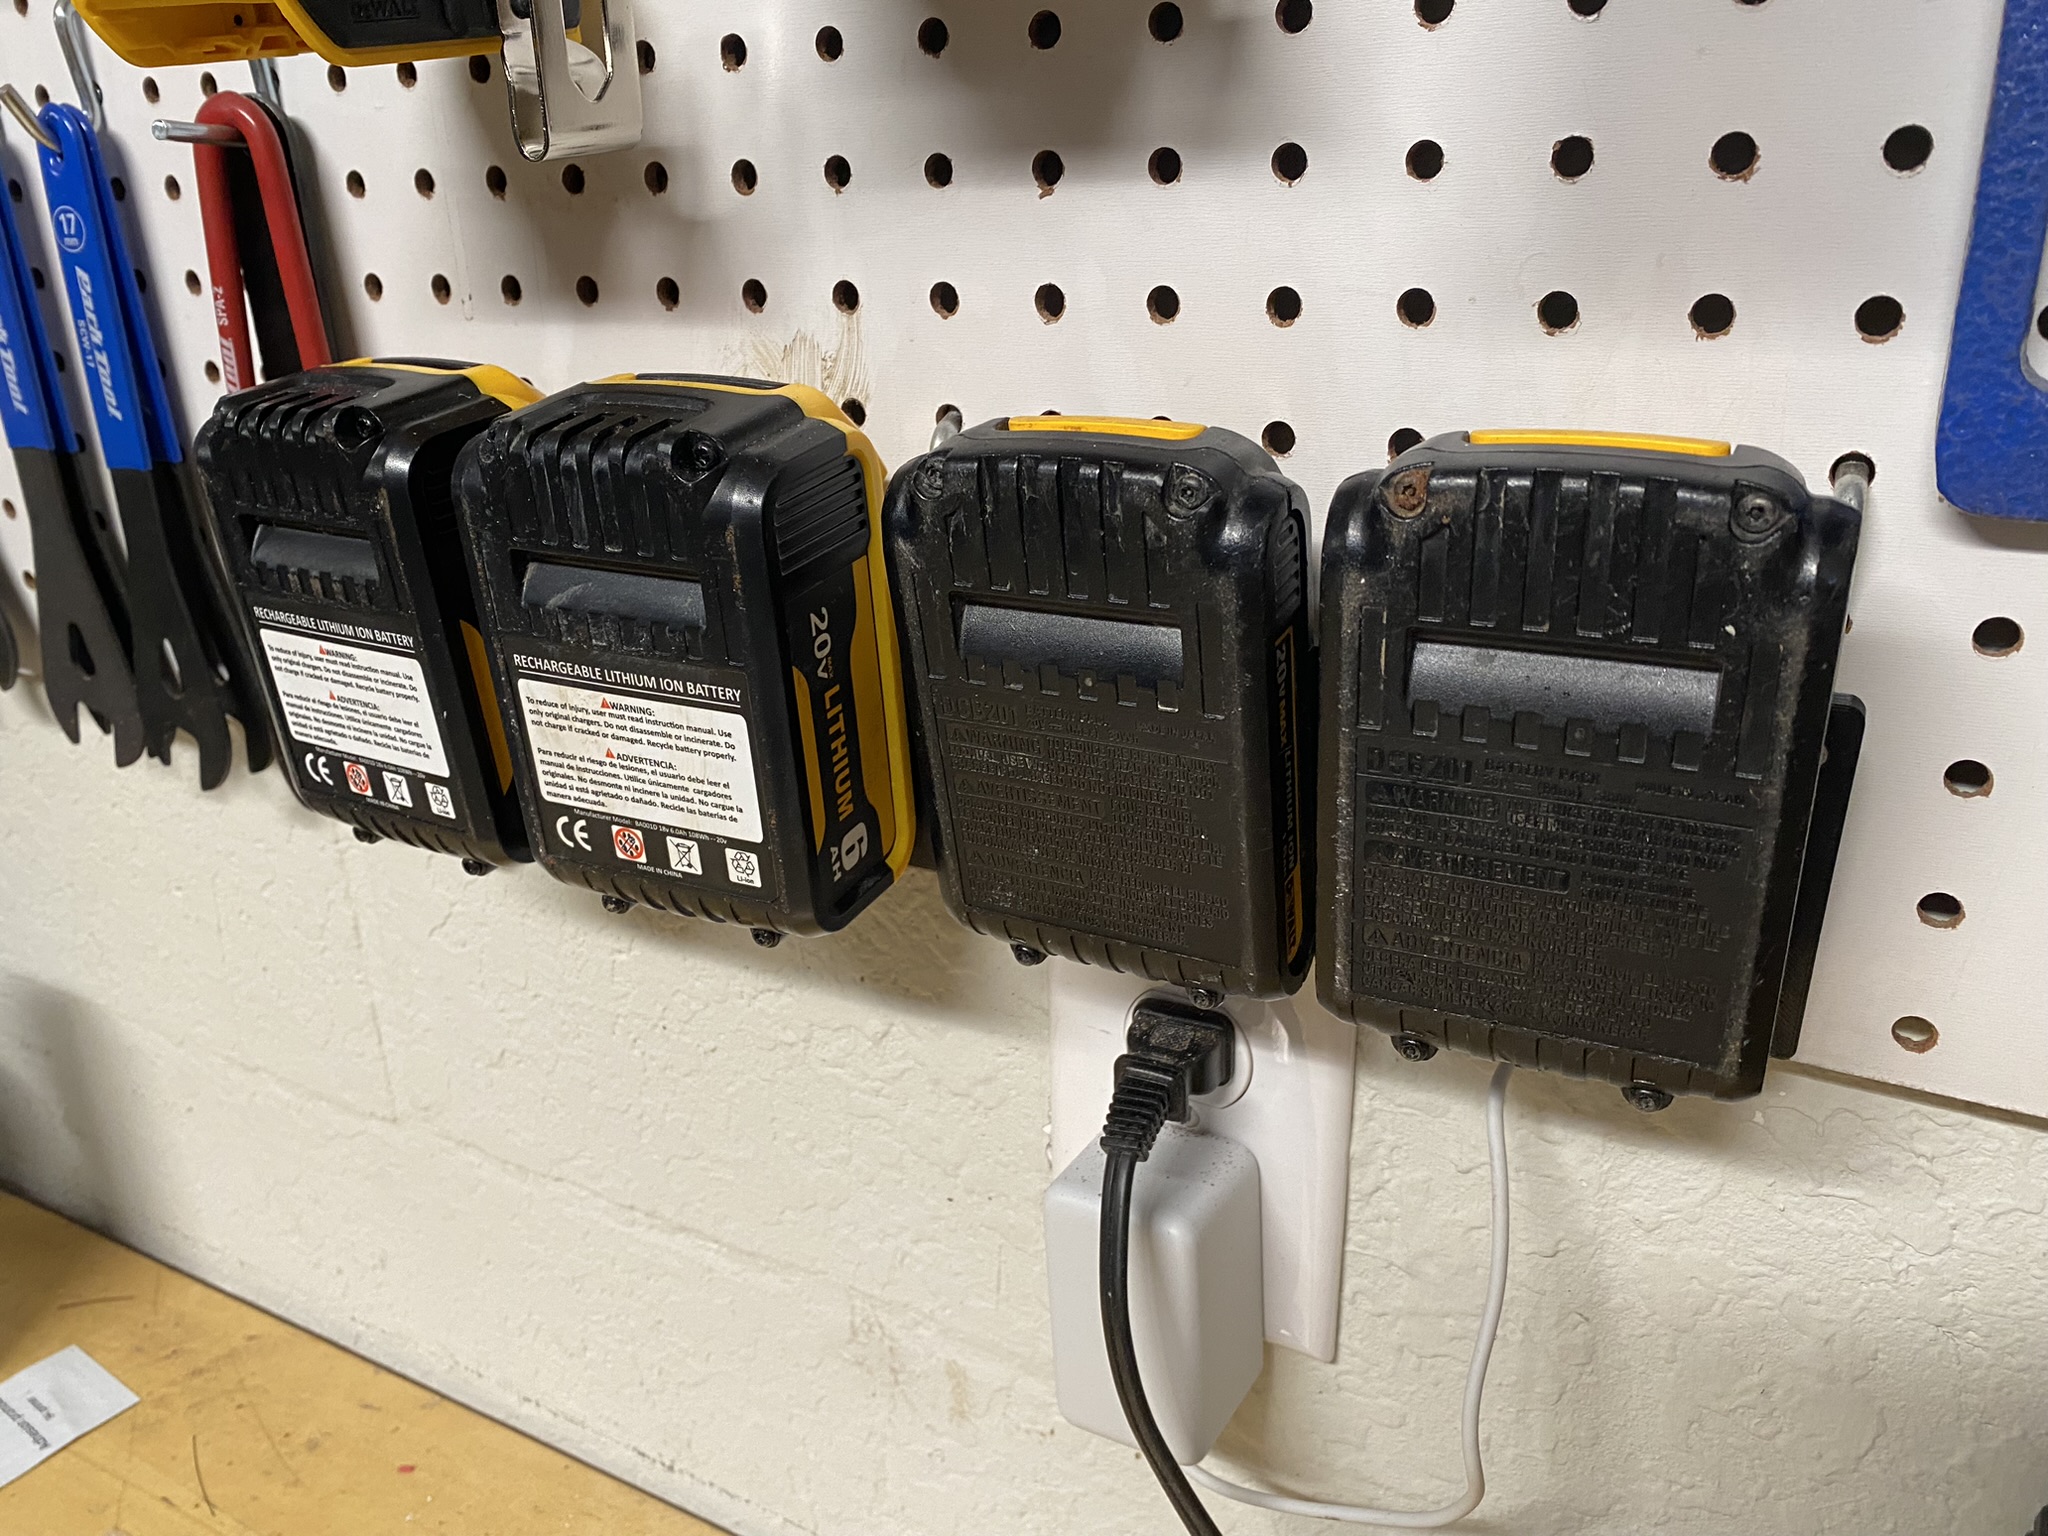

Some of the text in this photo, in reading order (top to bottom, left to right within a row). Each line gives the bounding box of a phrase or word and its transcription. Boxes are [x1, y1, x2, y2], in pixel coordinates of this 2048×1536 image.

[58, 213, 75, 235] 17
[75, 266, 122, 421] Park Tool
[253, 606, 413, 647] RECHARGEABLE LITHIUM ION BATTERY
[513, 653, 741, 702] RECHARGEABLE LITHIUM ION BATTERY
[525, 695, 535, 705] To
[535, 699, 559, 709] reduce
[559, 702, 568, 710] of
[591, 709, 607, 717] user
[607, 712, 627, 721] must
[627, 715, 644, 724] read
[644, 716, 685, 731] instruction
[717, 728, 732, 739] Use
[528, 708, 544, 718] only
[544, 711, 571, 722] original
[603, 720, 615, 729] Do
[615, 724, 628, 732] not
[628, 725, 673, 740] disassemble
[724, 741, 736, 750] Do
[608, 701, 655, 717] WARNING:
[530, 719, 544, 727] not
[544, 720, 567, 732] charge
[567, 724, 573, 732] if
[573, 727, 601, 738] cracked
[646, 739, 674, 751] Recycle
[674, 743, 702, 757] battery
[823, 683, 854, 821] LITHIUM
[967, 727, 1041, 756] WARNING
[537, 747, 553, 757] Para
[553, 751, 578, 761] reducir
[578, 755, 586, 763] el
[586, 756, 608, 768] riesgo
[608, 760, 618, 769] de
[650, 768, 658, 776] el
[658, 771, 686, 781] usuario
[686, 775, 706, 785] debe
[706, 778, 721, 788] leer
[722, 781, 730, 790] el
[539, 759, 565, 769] manual
[565, 763, 575, 771] de
[623, 773, 647, 785] Utilice
[647, 778, 690, 793] únicamente
[692, 788, 733, 801] cargadores
[616, 752, 677, 771] ADVERTENCIA:
[543, 780, 568, 790] unidad
[575, 786, 590, 794] está
[590, 789, 624, 801] agrietado
[660, 801, 685, 813] Recicle
[685, 806, 697, 815] las
[697, 808, 728, 821] baterías
[728, 814, 738, 824] de
[546, 790, 572, 801] manera
[577, 775, 588, 784] No
[588, 777, 623, 791] desmonte
[631, 785, 661, 798] incinere
[661, 791, 669, 799] la
[697, 798, 710, 807] No
[710, 802, 735, 812] cargue
[735, 805, 744, 814] la
[974, 778, 1102, 817] AVERTISSEMENT
[1393, 785, 1496, 821] WARNING
[829, 846, 842, 882] AH
[841, 822, 869, 871] 6
[636, 863, 655, 873] MADE
[663, 869, 683, 879] CHINA
[985, 850, 1085, 885] ADVERTENCIA
[1394, 844, 1567, 893] AVERTISSEMENT
[1392, 929, 1524, 971] ADVERTENCIA
